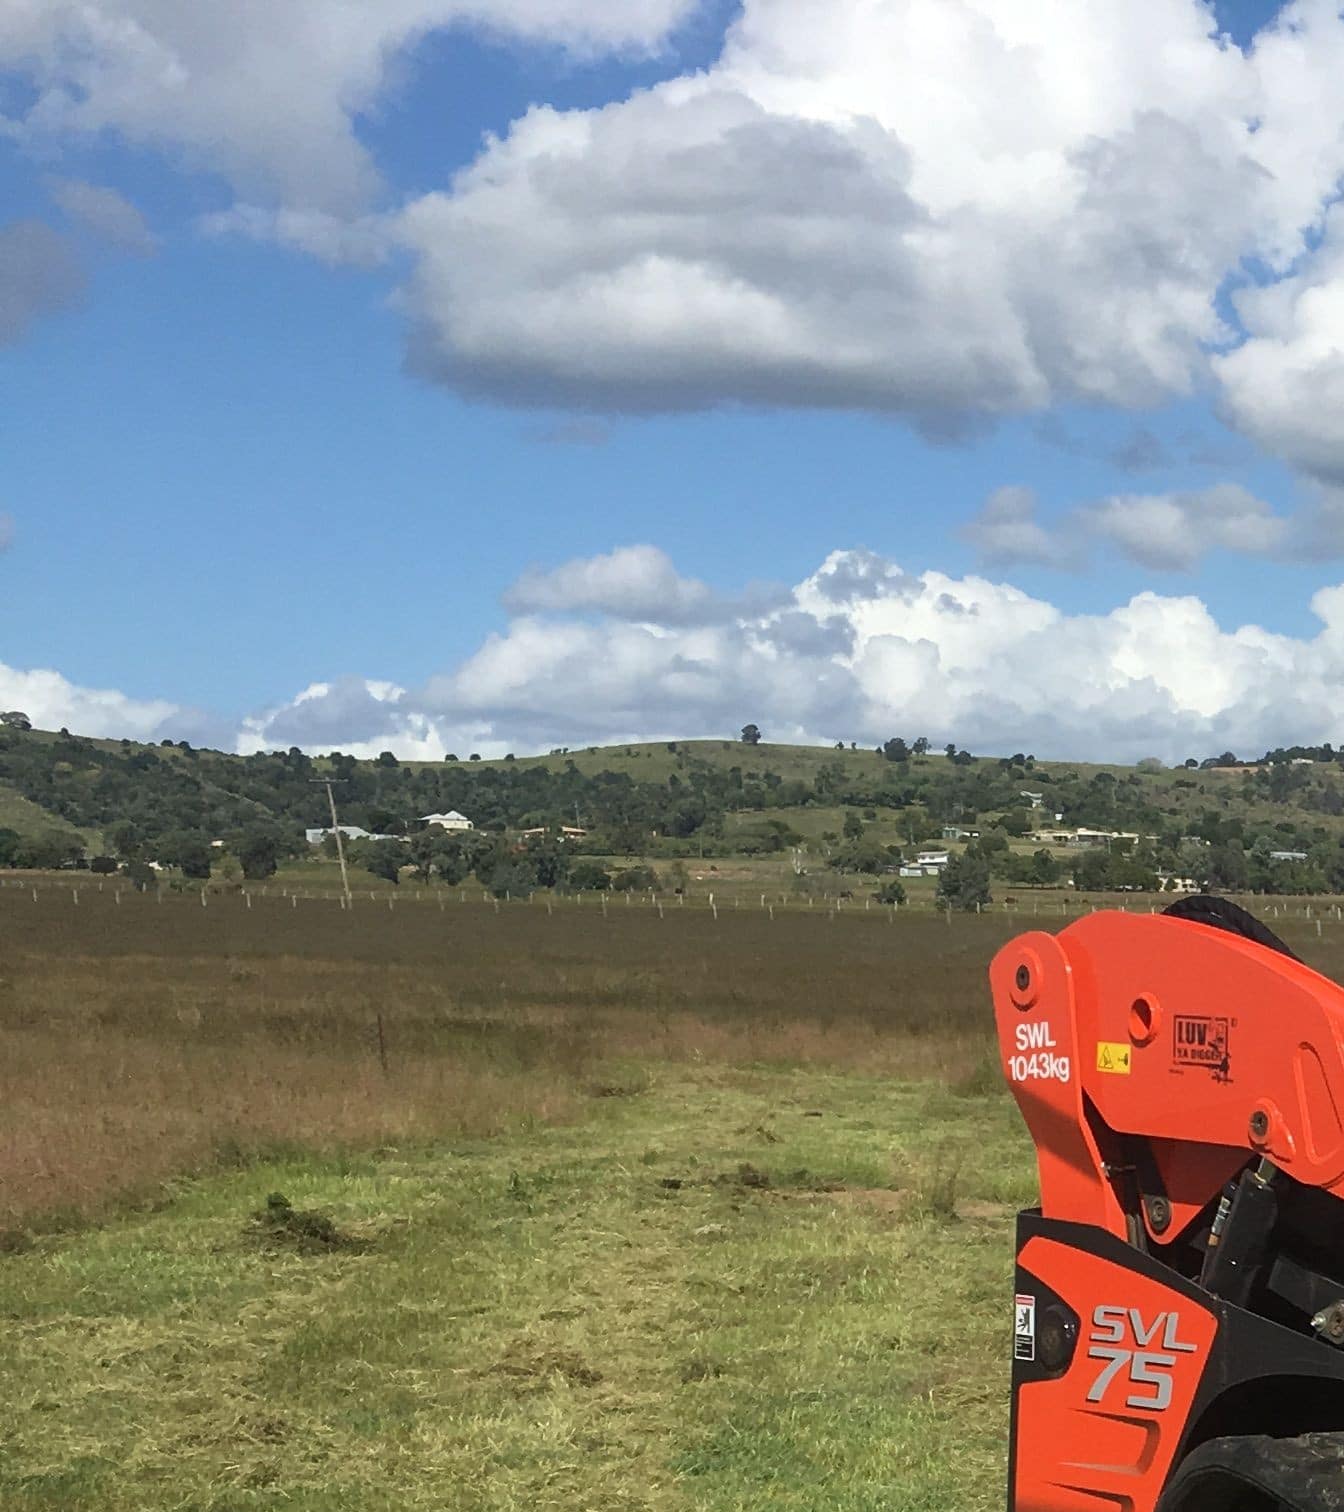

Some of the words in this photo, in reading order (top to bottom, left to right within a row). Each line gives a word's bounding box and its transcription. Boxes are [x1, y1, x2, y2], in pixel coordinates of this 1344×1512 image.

[1016, 1021, 1056, 1051] SWL
[1177, 1021, 1207, 1046] LUV
[1007, 1052, 1070, 1083] 1043kg
[1177, 1047, 1188, 1059] YA
[1090, 1304, 1198, 1352] SVL
[1086, 1346, 1177, 1411] 75
